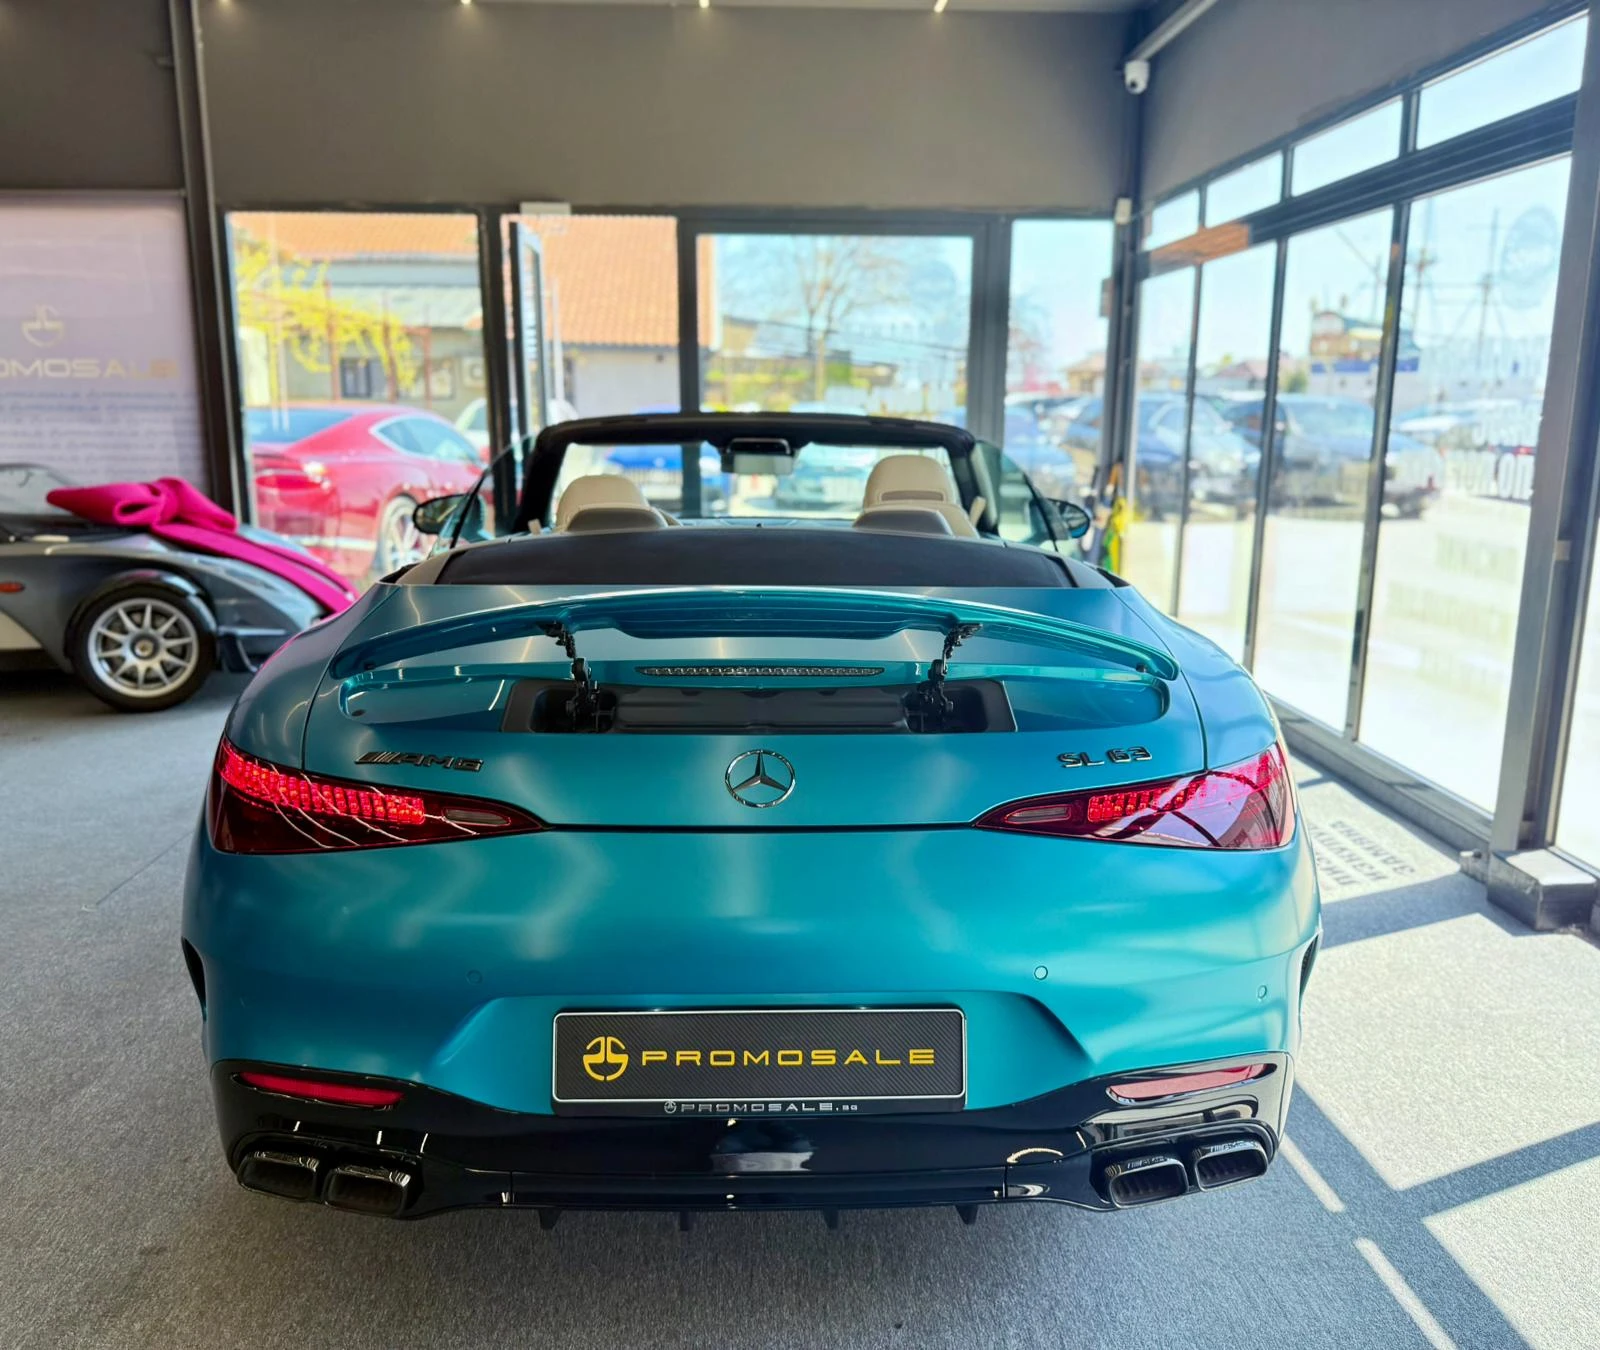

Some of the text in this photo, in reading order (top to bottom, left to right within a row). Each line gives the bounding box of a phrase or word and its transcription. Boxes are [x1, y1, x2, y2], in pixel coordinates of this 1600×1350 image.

[392, 752, 484, 772] AMG
[1057, 746, 1153, 768] SL 63
[641, 1048, 936, 1067] PROMOSALE
